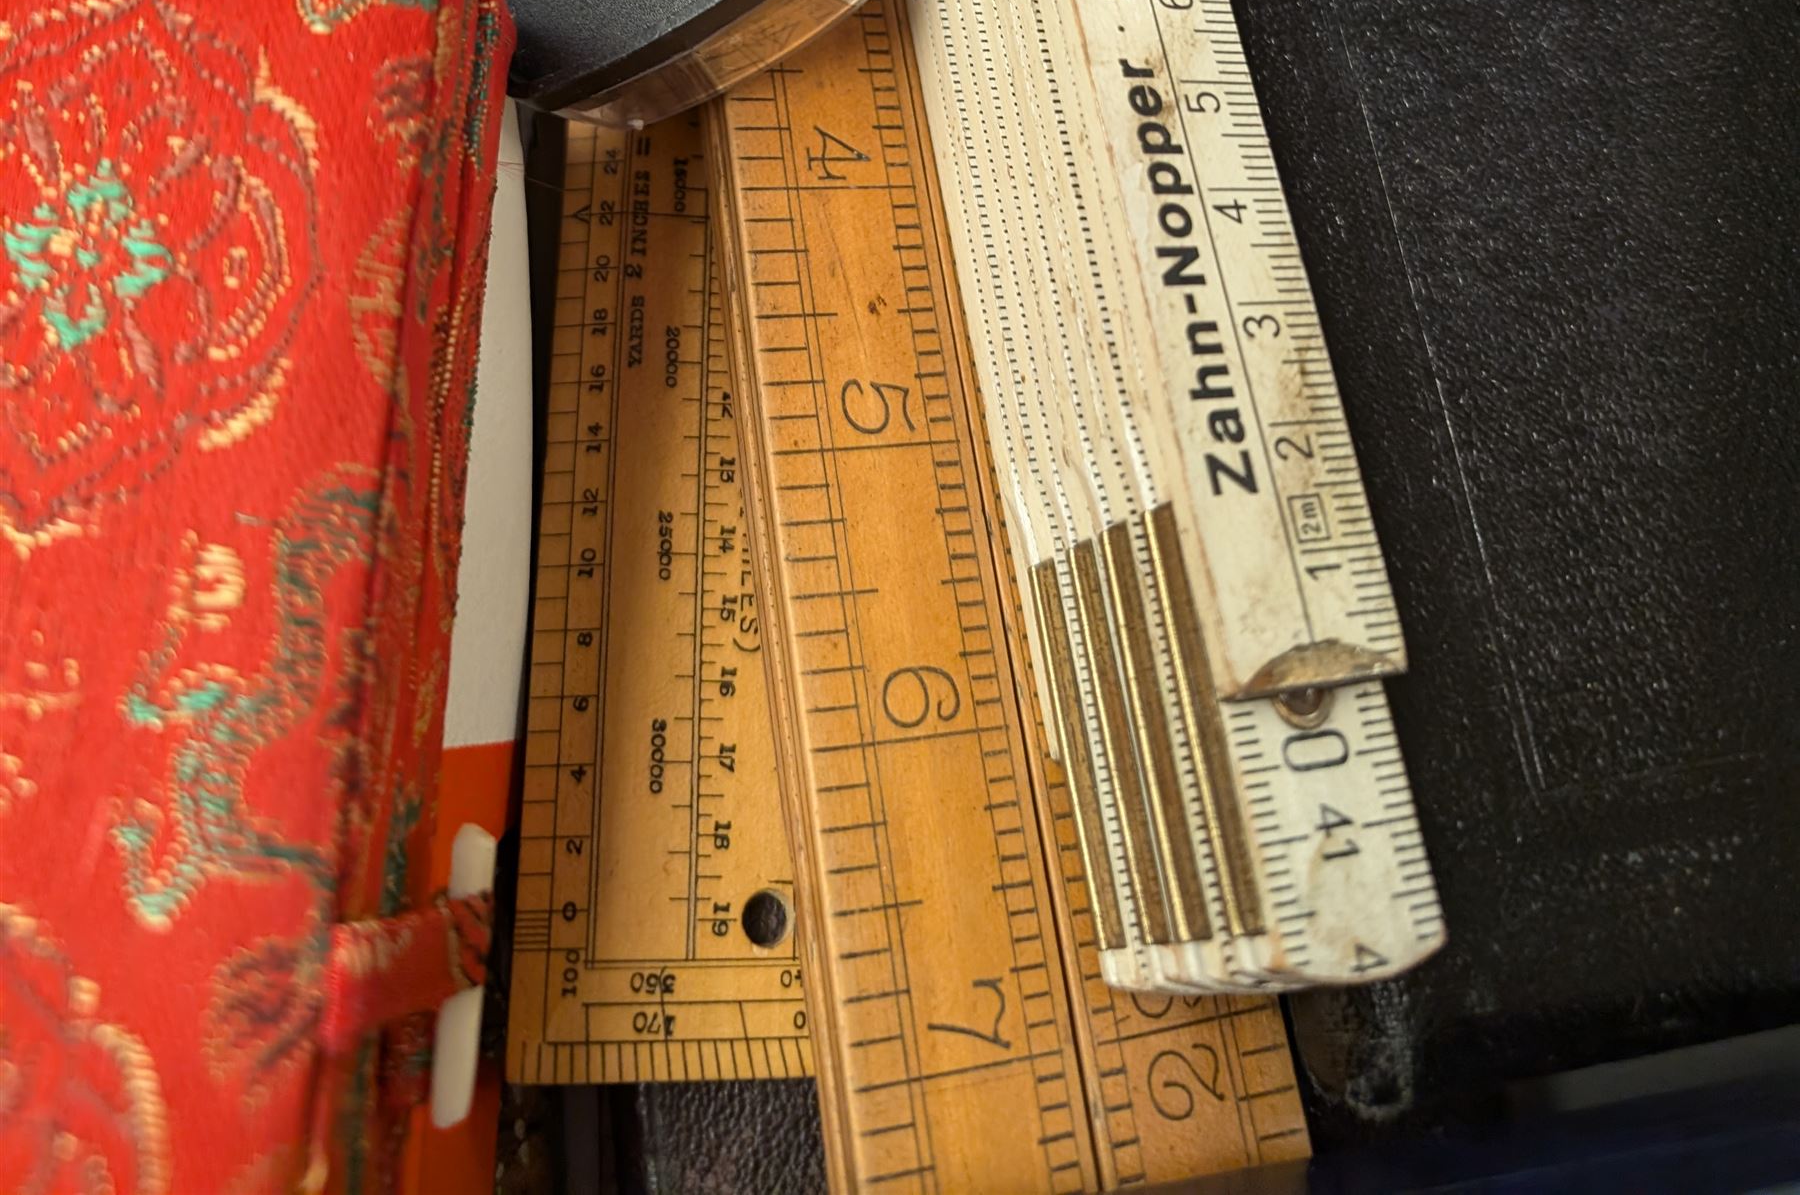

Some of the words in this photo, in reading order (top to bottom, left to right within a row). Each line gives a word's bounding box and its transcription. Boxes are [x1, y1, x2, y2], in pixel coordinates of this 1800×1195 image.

[1187, 91, 1221, 113] 5
[604, 149, 619, 176] 24
[807, 126, 870, 181] 4
[673, 157, 688, 213] 15000
[601, 200, 616, 226] 22
[632, 169, 650, 256] INCHES
[1213, 199, 1247, 224] 4
[594, 255, 610, 282] 20
[625, 263, 642, 279] 2
[1118, 58, 1259, 499] Zahn-Nopper
[593, 308, 608, 336] 18
[628, 295, 645, 369] YARDS
[1242, 314, 1281, 339] 3
[666, 326, 681, 388] 20000
[589, 364, 606, 393] 16
[841, 379, 916, 434] 5
[587, 422, 603, 454] 14
[1275, 434, 1315, 462] 2
[719, 456, 737, 484] 13
[582, 488, 600, 517] 12
[657, 510, 673, 581] 25000
[718, 525, 736, 553] 14
[577, 548, 597, 579] 10
[1304, 564, 1342, 581] 1
[720, 594, 738, 623] 15
[577, 631, 593, 647] 8
[719, 666, 737, 698] 16
[882, 665, 961, 728] 6
[573, 696, 589, 712] 6
[649, 718, 667, 794] 30000
[719, 743, 737, 773] 17
[1282, 729, 1349, 772] 0
[571, 765, 587, 783] 4
[714, 820, 731, 850] 18
[1316, 803, 1361, 861] 41
[566, 839, 584, 855] 2
[562, 901, 577, 922] 0
[711, 902, 730, 937] 19
[562, 949, 581, 998] 100
[630, 972, 676, 994] 350
[633, 1012, 676, 1037] 170
[927, 977, 1012, 1049] 7
